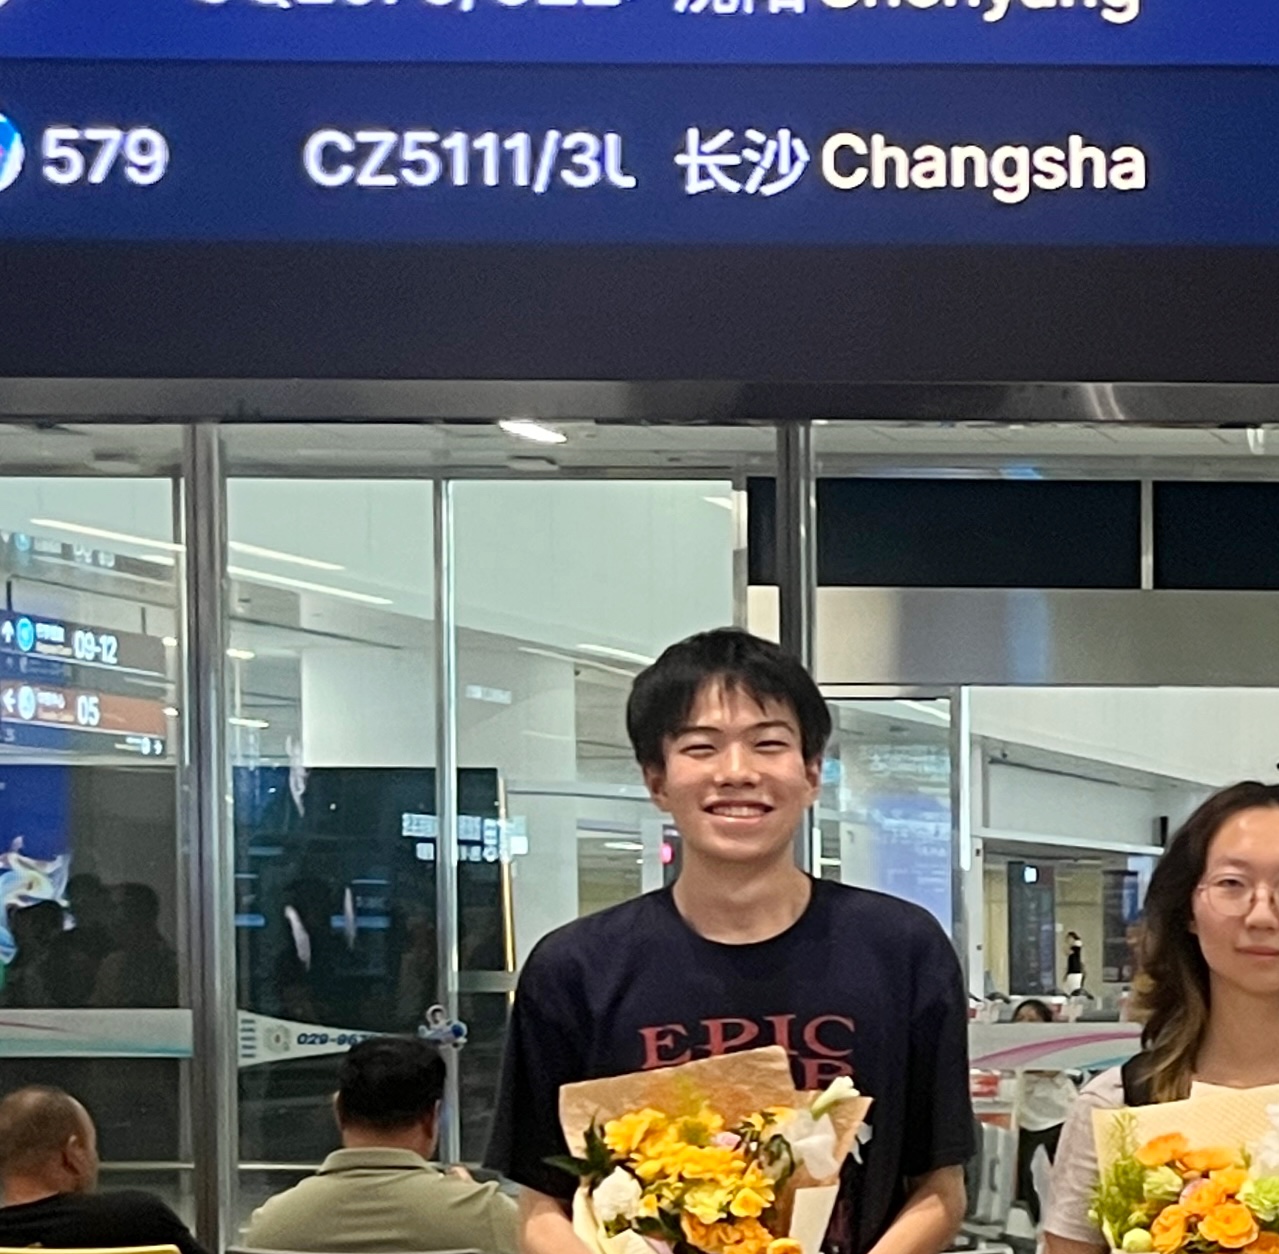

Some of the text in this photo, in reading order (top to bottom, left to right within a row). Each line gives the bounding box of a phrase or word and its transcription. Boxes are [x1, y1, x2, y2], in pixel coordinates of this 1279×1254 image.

[41, 126, 170, 186] 579
[673, 126, 1147, 205] 长沙 Changsha
[638, 1013, 856, 1070] EPIC
